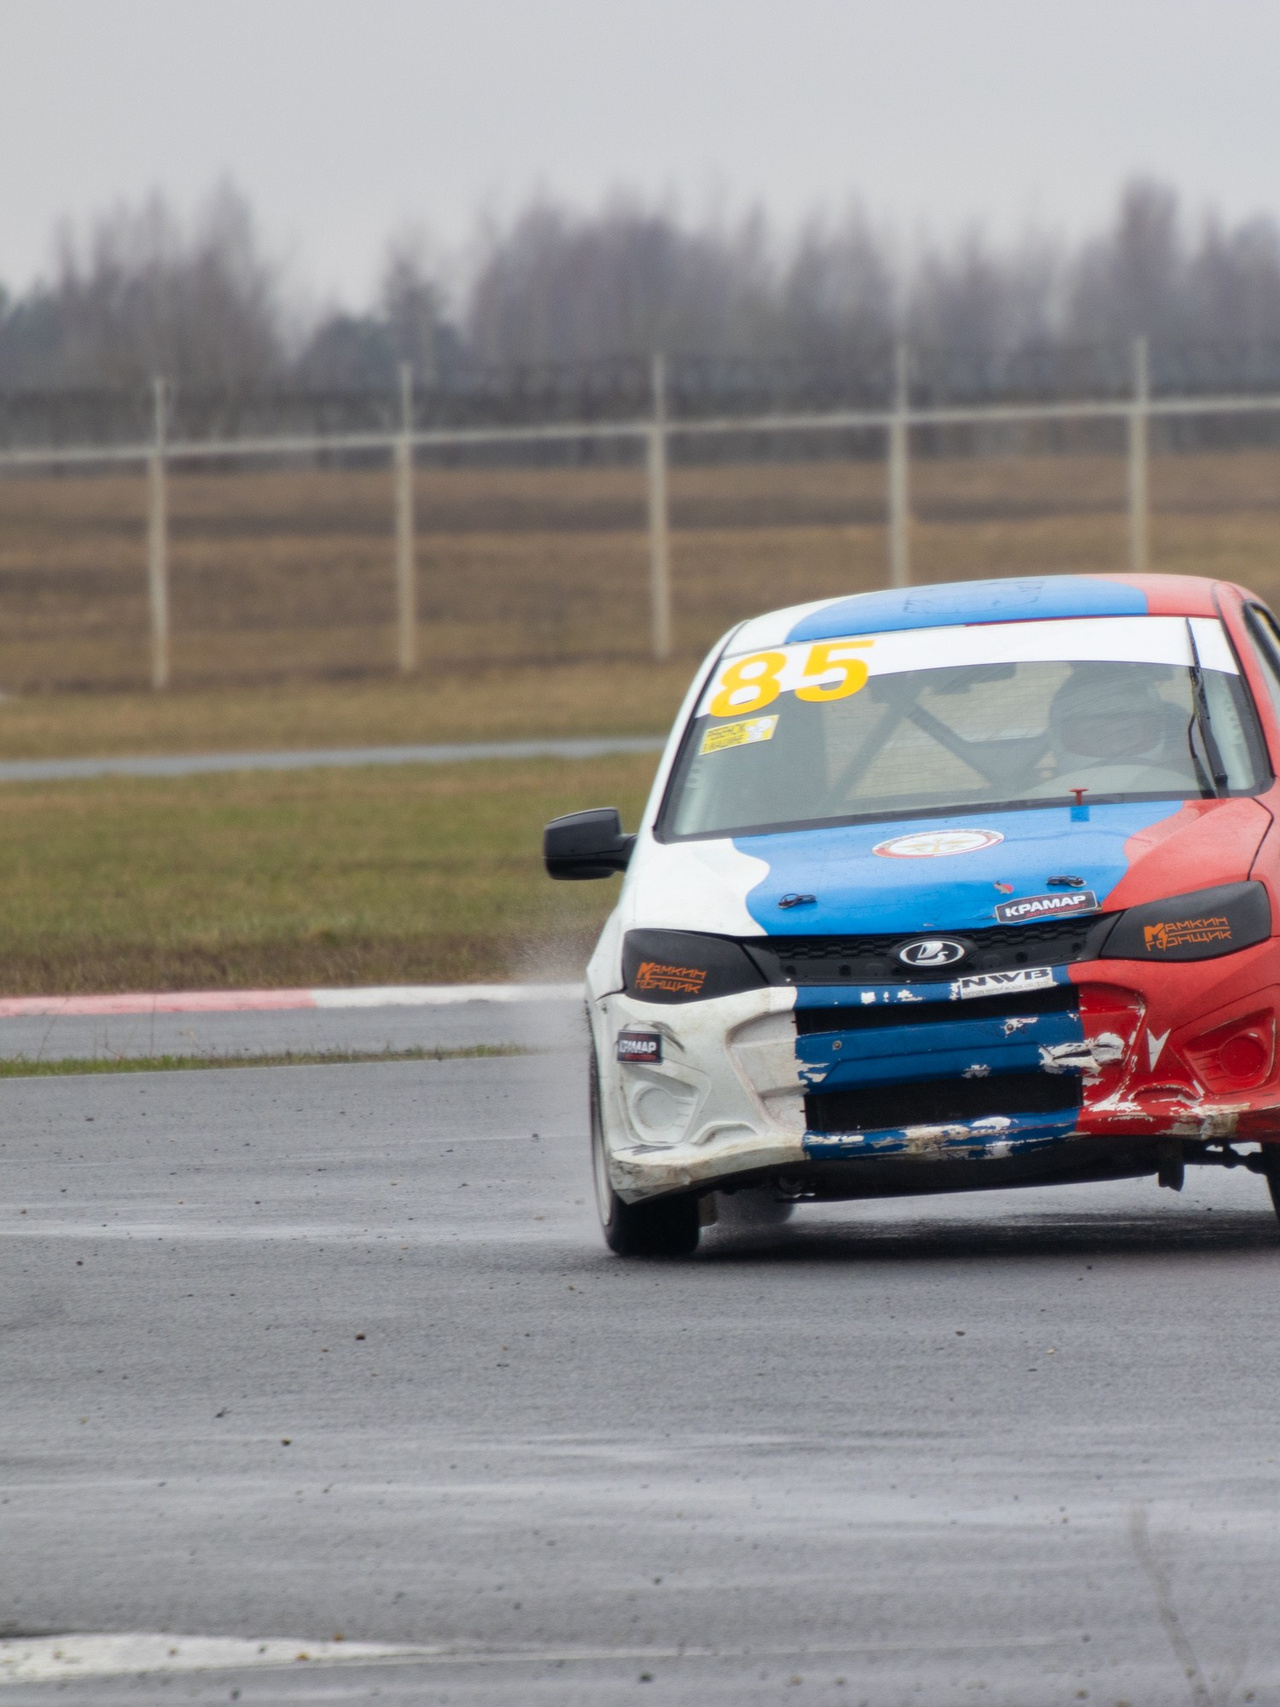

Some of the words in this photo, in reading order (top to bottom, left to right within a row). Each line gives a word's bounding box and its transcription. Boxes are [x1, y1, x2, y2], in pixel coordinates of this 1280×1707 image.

[709, 640, 875, 717] 85
[1005, 895, 1086, 917] КРАМАР
[1144, 916, 1228, 951] МАМКИН
[962, 968, 1049, 988] NWB
